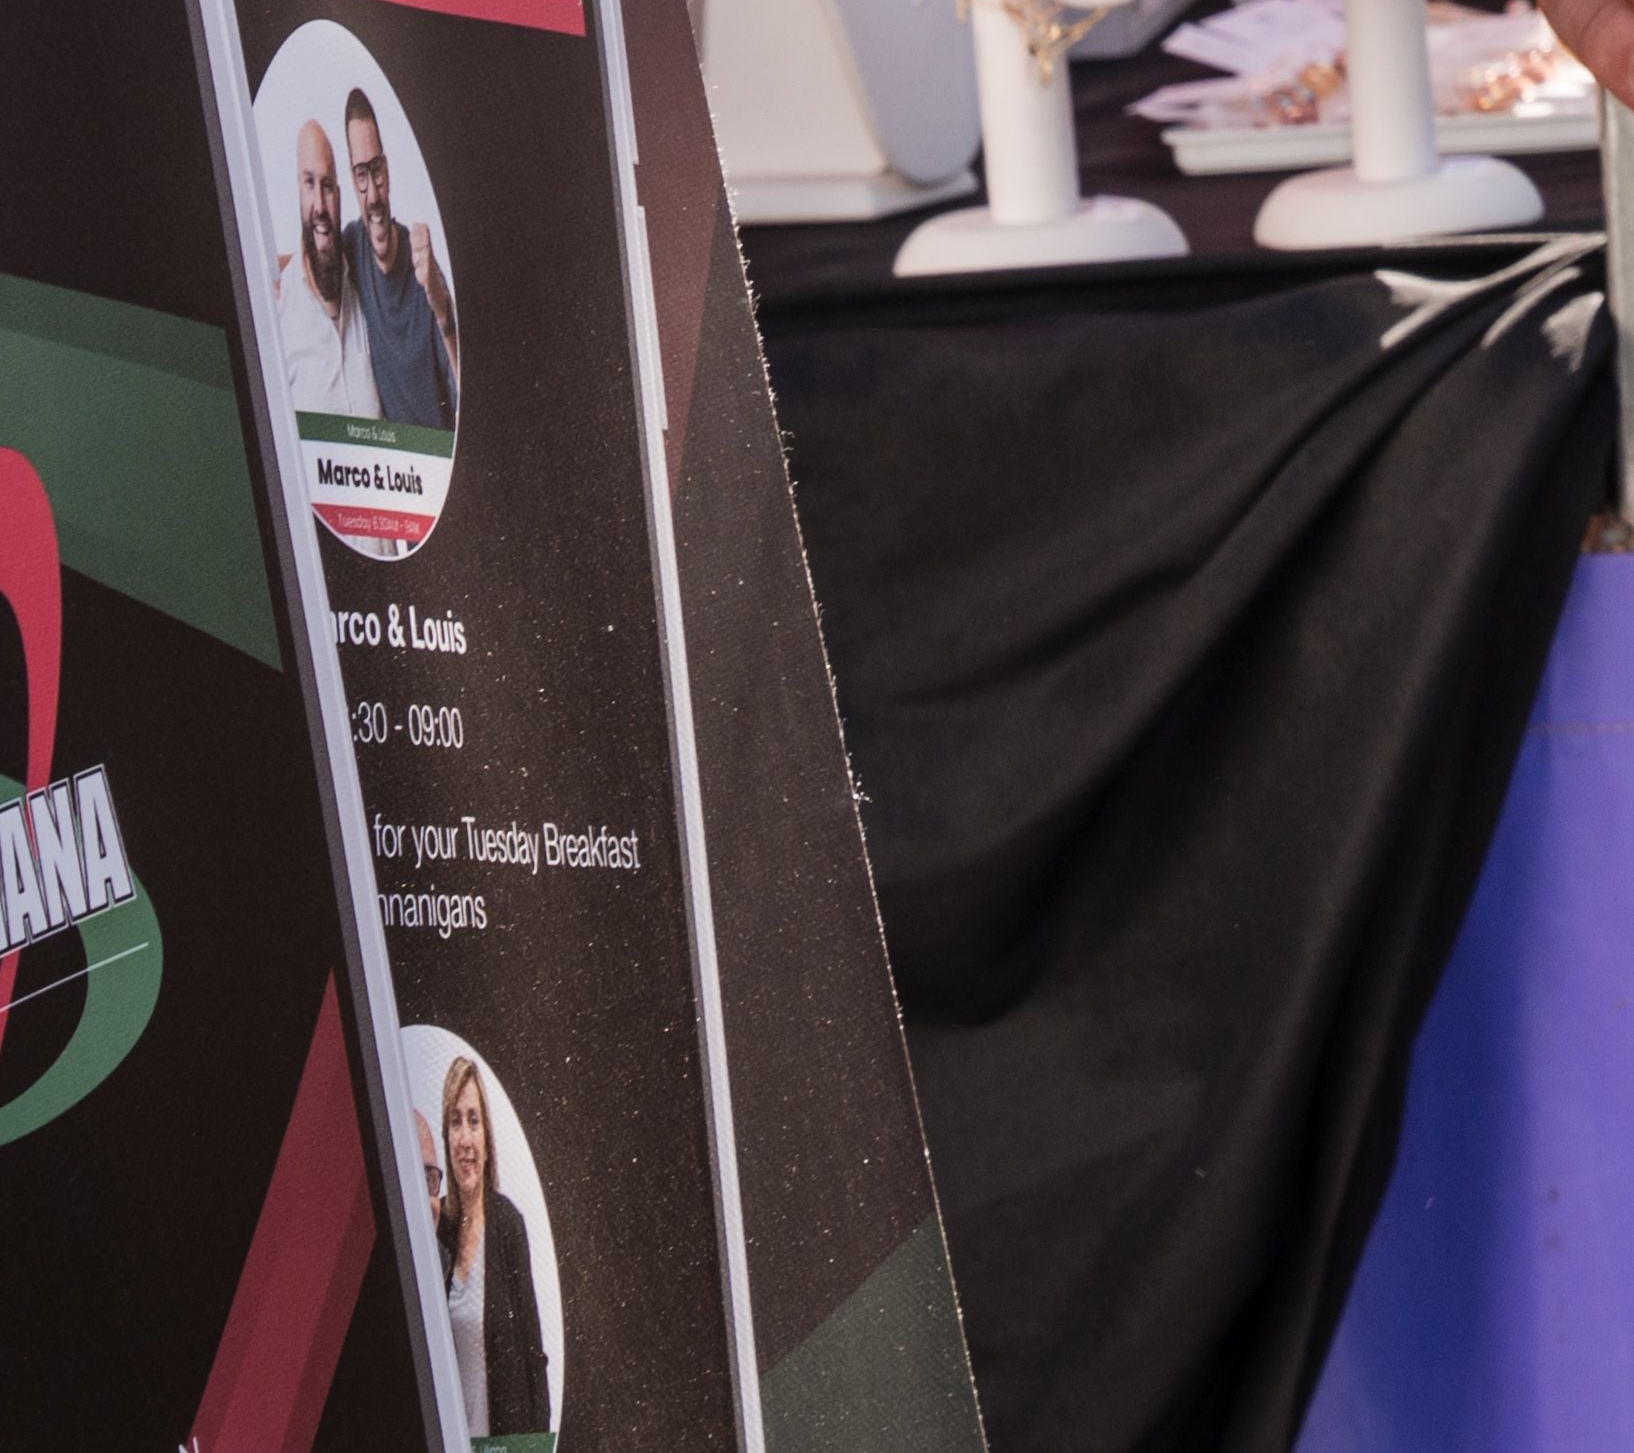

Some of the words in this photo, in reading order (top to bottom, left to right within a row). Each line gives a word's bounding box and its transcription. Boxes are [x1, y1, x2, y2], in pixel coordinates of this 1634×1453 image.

[316, 458, 371, 488] Marco
[374, 463, 385, 491] &
[387, 465, 424, 495] Louis
[387, 603, 406, 647] &
[408, 605, 467, 655] Louis
[408, 704, 464, 749] 09:00
[373, 813, 405, 858] for
[411, 825, 458, 869] your
[461, 816, 540, 875] Tuesday
[543, 822, 641, 869] Breakfast
